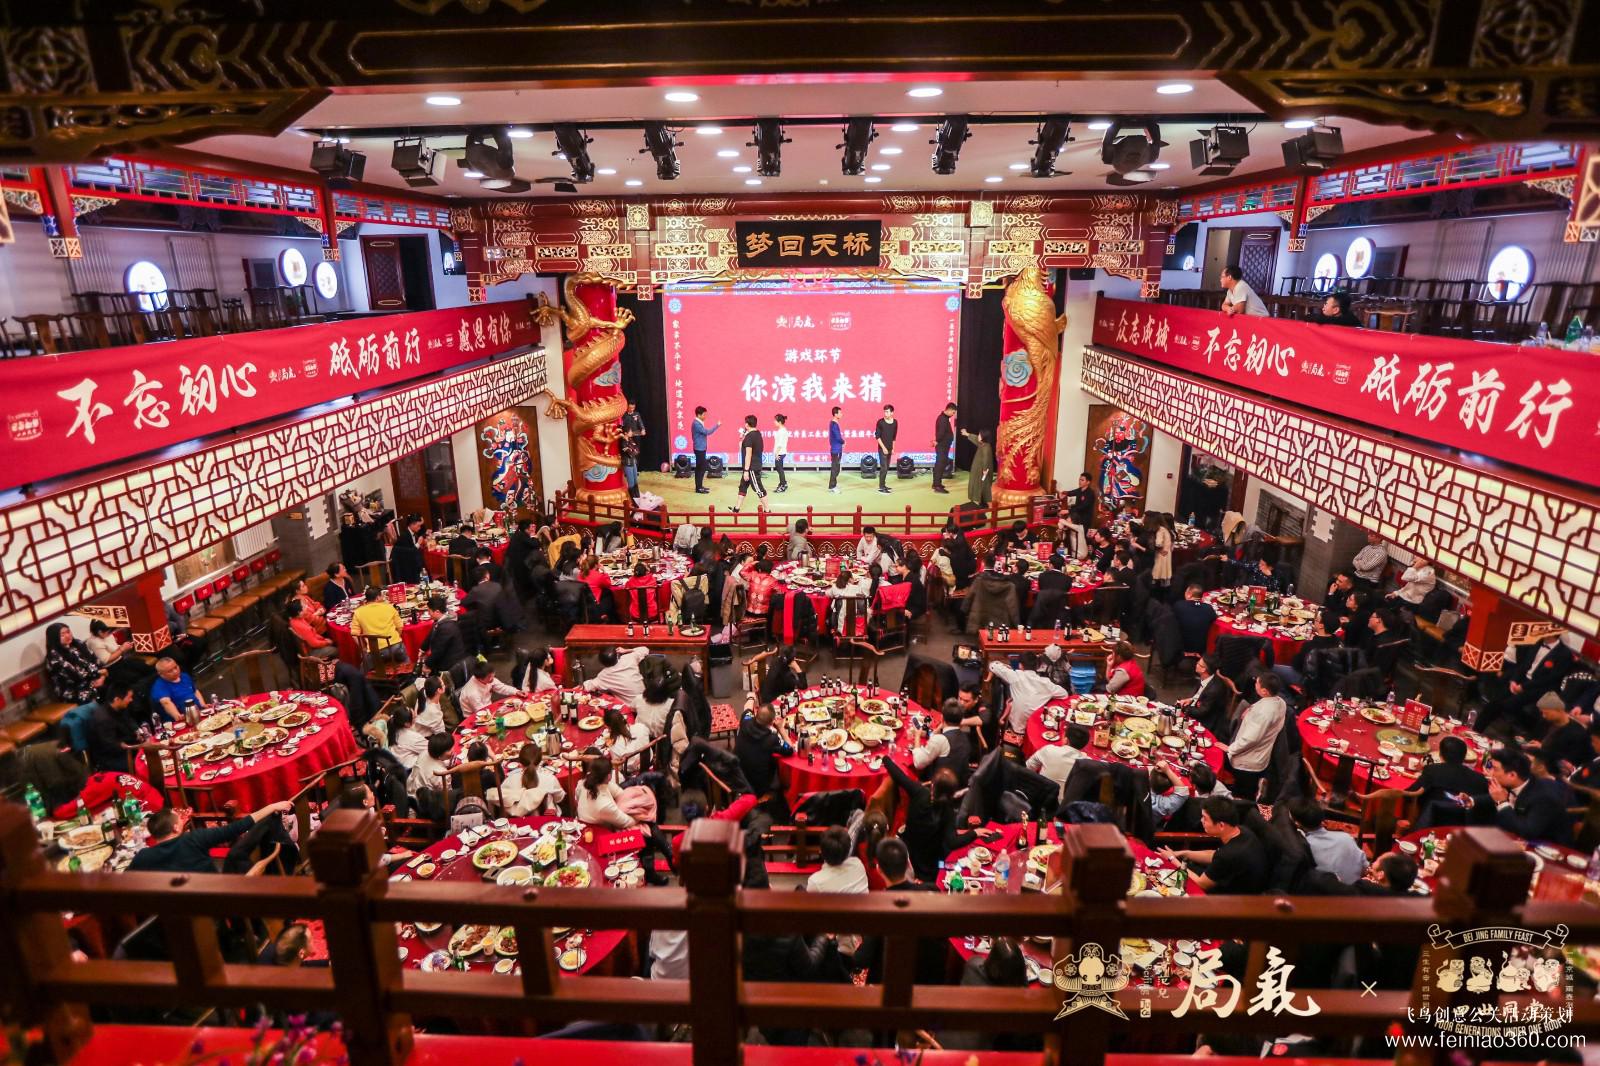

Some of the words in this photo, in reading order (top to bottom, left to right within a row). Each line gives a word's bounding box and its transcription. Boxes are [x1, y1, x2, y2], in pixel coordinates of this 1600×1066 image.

[745, 232, 872, 258] 梦回天桥
[458, 309, 512, 352] 感恩有你
[1115, 309, 1169, 354] 众志成城
[1202, 328, 1295, 378] 不忘初心
[329, 329, 420, 380] 砥砺前行
[784, 348, 842, 363] 游戏环节
[57, 360, 257, 444] 不忘初心
[741, 372, 887, 403] 你演我来猜
[1360, 353, 1574, 449] 砥砺前行
